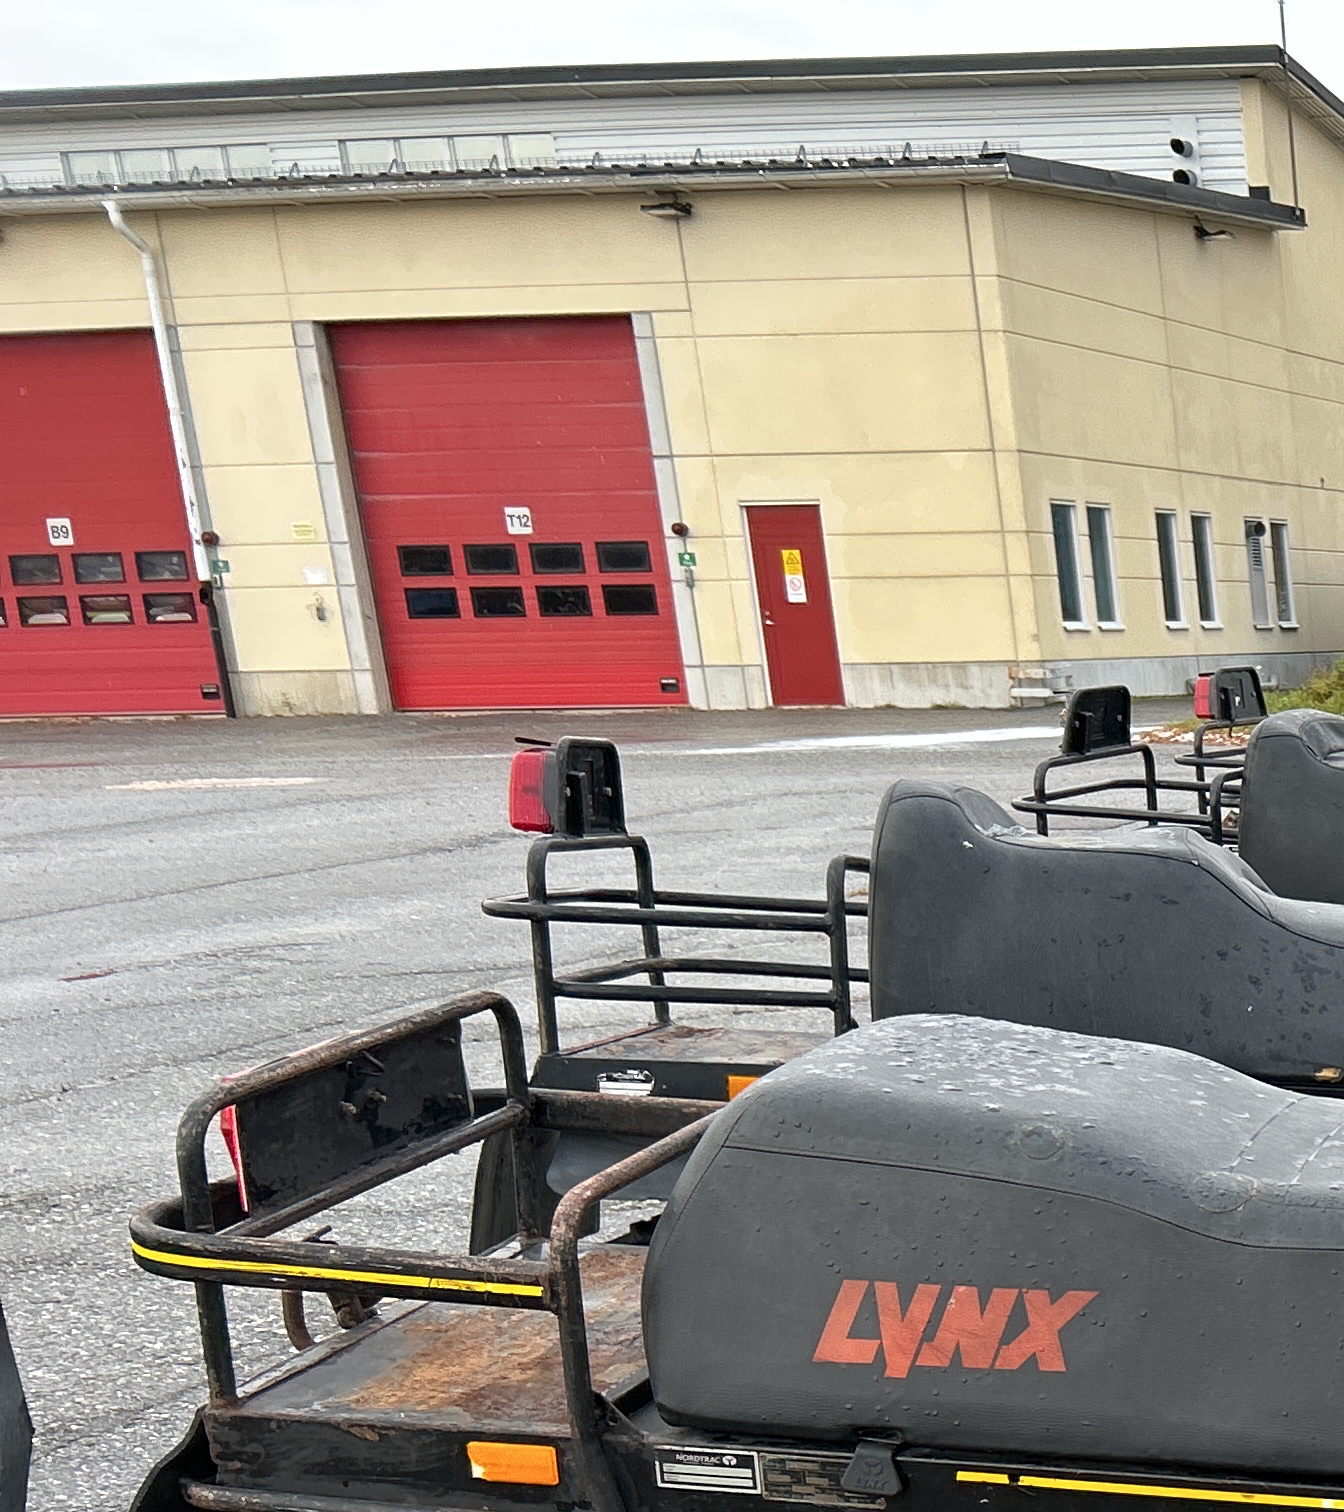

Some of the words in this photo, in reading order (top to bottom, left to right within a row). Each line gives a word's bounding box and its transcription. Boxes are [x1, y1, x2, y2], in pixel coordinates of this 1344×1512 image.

[506, 514, 531, 528] T12
[50, 525, 69, 539] B9
[812, 1280, 1099, 1379] LYNX
[675, 1453, 721, 1464] NORDTRAC
